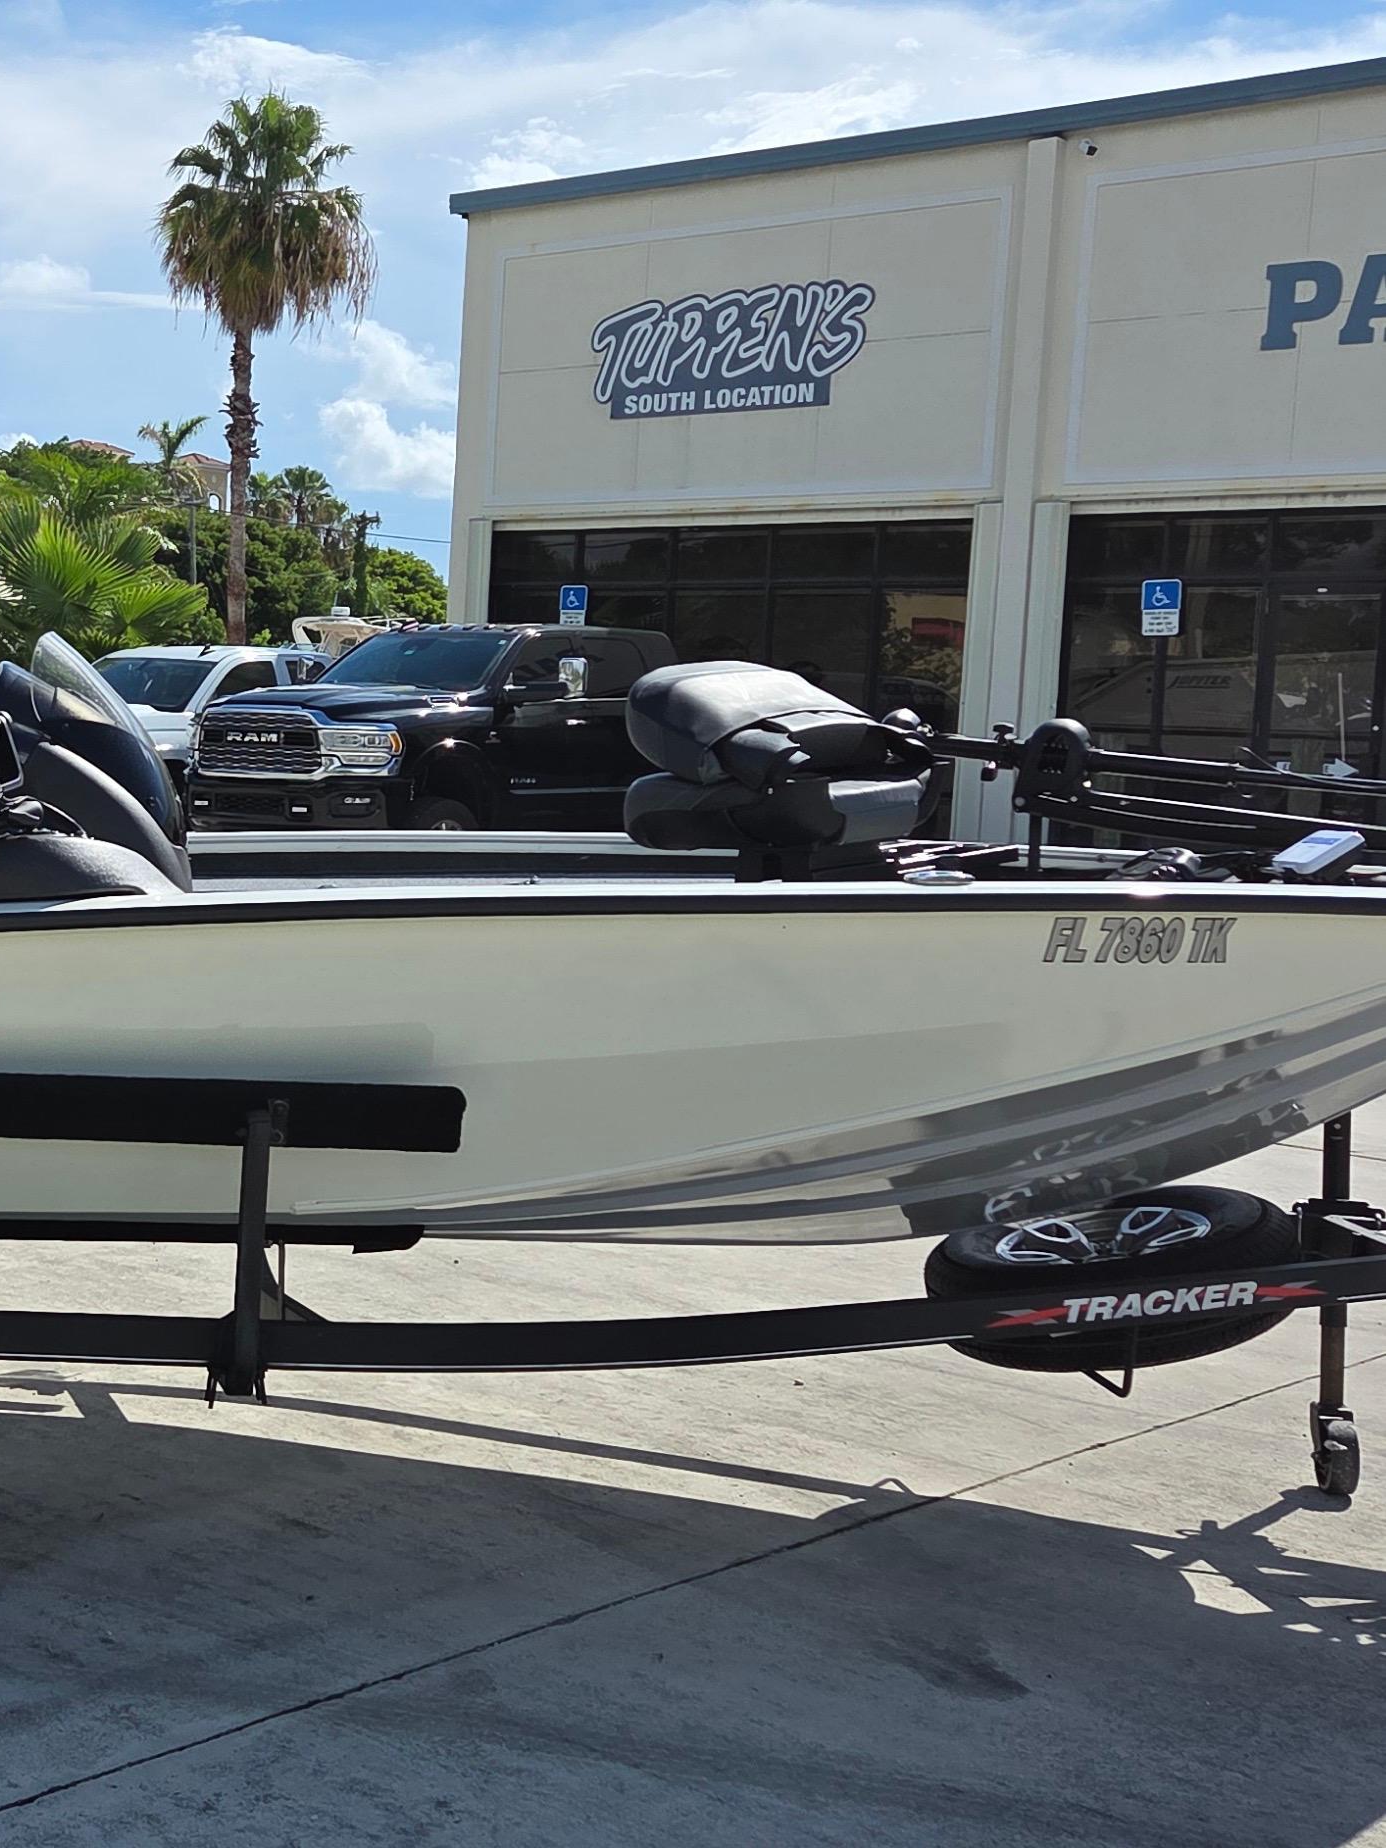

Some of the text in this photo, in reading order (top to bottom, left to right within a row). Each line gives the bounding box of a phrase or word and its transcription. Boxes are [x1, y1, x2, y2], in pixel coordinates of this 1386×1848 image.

[624, 382, 814, 415] SOUTH LOCATION
[227, 731, 278, 743] RAM
[1042, 917, 1238, 964] FL 7860 TK
[1064, 1281, 1257, 1323] TRACKER
